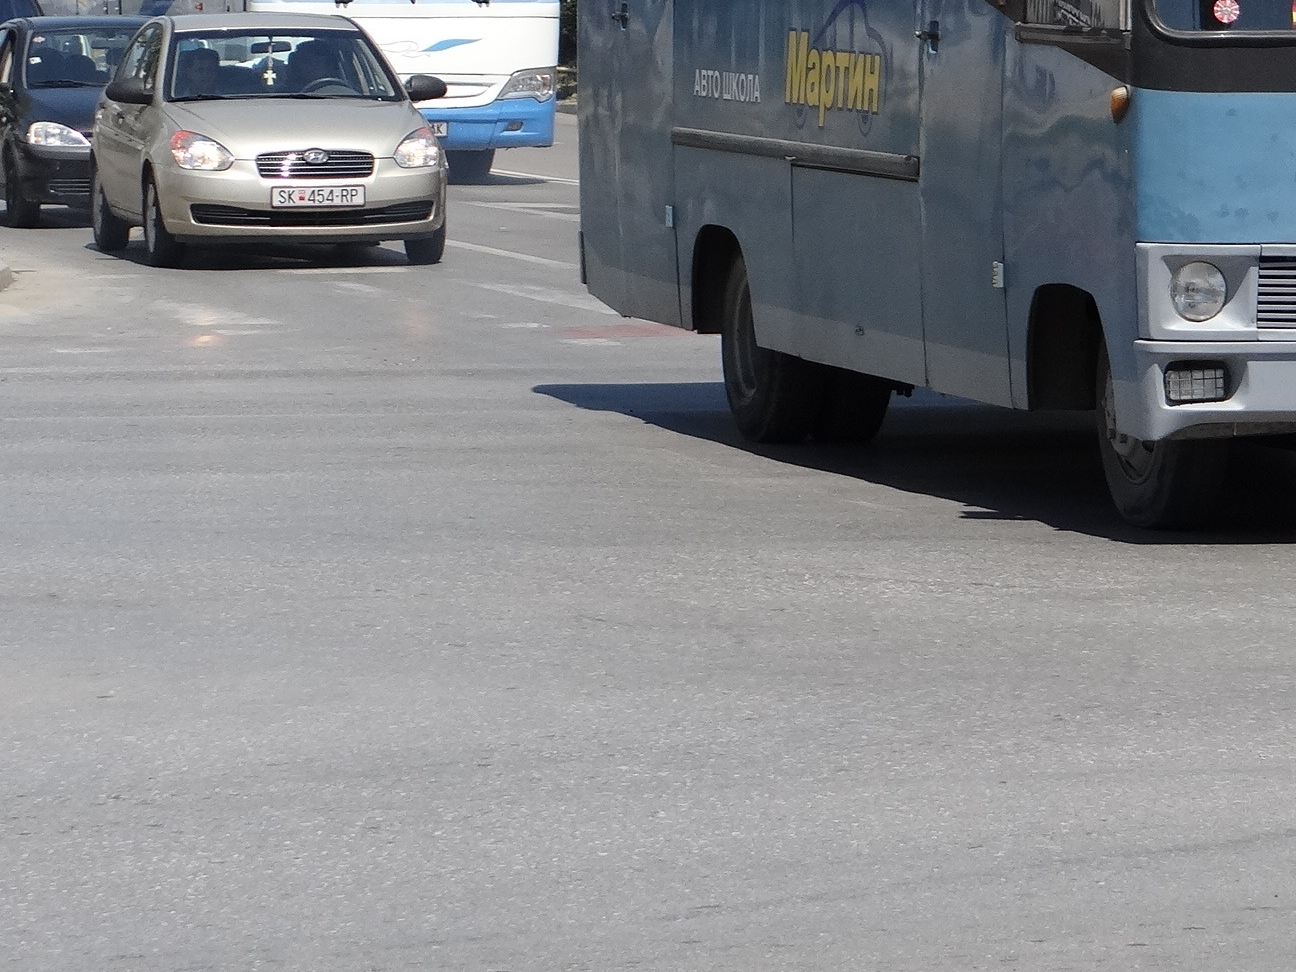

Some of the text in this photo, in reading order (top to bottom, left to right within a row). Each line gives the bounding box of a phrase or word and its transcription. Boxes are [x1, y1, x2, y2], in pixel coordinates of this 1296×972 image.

[693, 69, 761, 103] АВТО ШКОЛА
[784, 29, 880, 127] Мартин
[278, 189, 296, 204] SK
